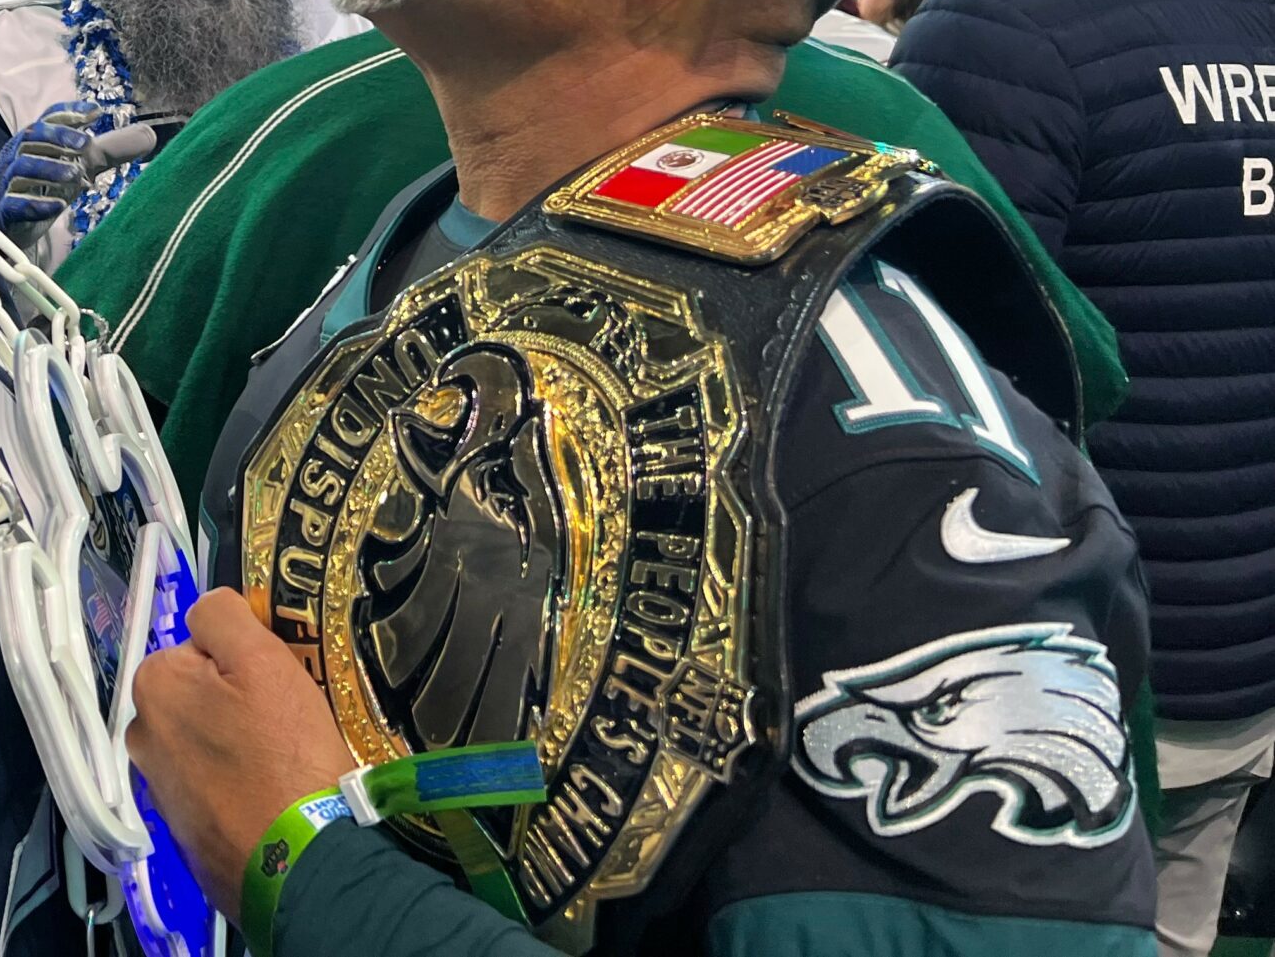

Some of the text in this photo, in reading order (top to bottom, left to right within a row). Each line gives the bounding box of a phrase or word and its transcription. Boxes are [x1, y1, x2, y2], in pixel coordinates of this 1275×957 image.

[1158, 63, 1275, 125] WRE
[1242, 157, 1275, 216] B
[631, 406, 703, 500] THE
